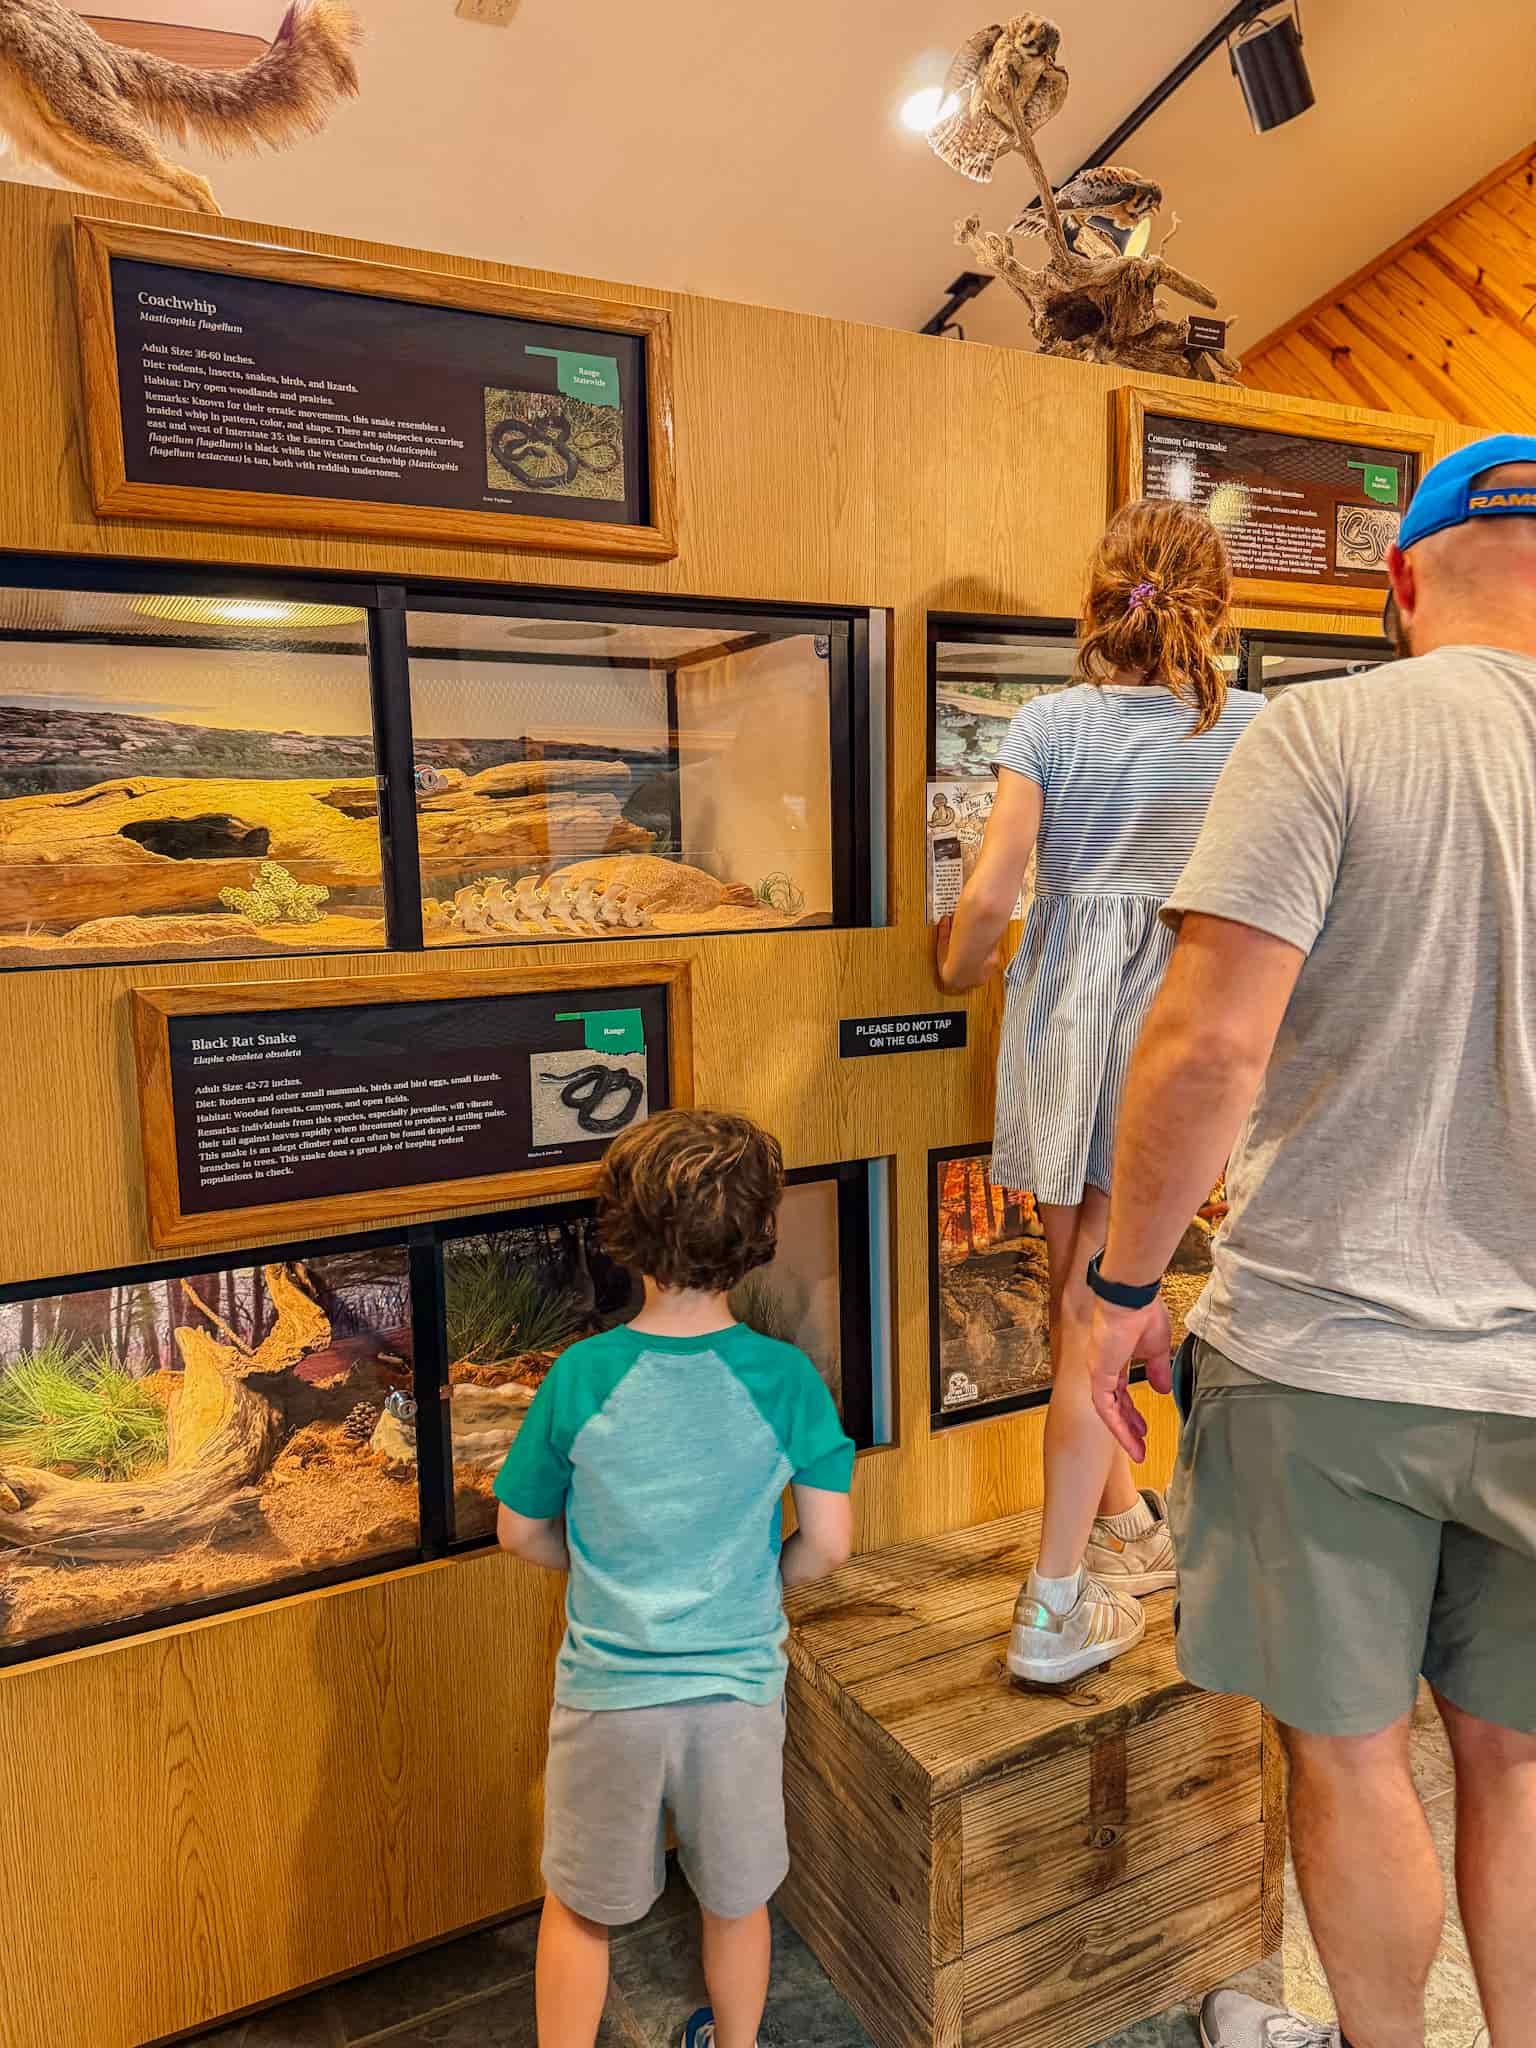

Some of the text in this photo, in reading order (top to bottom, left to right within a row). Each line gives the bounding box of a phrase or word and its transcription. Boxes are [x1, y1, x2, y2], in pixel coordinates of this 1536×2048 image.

[138, 292, 216, 315] Coachwhip
[140, 311, 242, 333] Masticophis flagellum
[142, 343, 168, 353] Adult
[195, 349, 221, 360] 36-60
[183, 379, 201, 391] Dry
[203, 383, 227, 392] open
[228, 386, 278, 398] woodlands
[279, 392, 297, 401] and
[308, 380, 325, 388] and
[191, 396, 225, 408] Known
[227, 399, 240, 409] for
[243, 402, 264, 412] their
[266, 406, 296, 416] erratic
[352, 414, 369, 424] this
[370, 417, 395, 427] snake
[397, 421, 439, 431] resembles
[146, 404, 182, 416] braided
[184, 409, 208, 421] whip
[210, 411, 220, 421] in
[287, 421, 304, 430] and
[335, 425, 360, 436] There
[362, 429, 376, 437] are
[378, 431, 423, 442] subspecies
[424, 437, 464, 448] occurring
[147, 420, 166, 428] east
[169, 422, 186, 430] and
[189, 424, 210, 433] west
[213, 425, 223, 434] of
[225, 426, 269, 439] Interstate
[286, 433, 301, 442] the
[303, 435, 335, 446] Eastern
[337, 438, 384, 452] Coachwhip
[385, 444, 437, 456] (Masticophis
[1147, 433, 1228, 452] Common Gartersnake
[148, 432, 193, 444] flagellum
[244, 441, 252, 450] is
[254, 442, 279, 453] black
[281, 446, 305, 456] while
[307, 448, 321, 457] the
[323, 450, 358, 461] Western
[359, 454, 406, 467] Coachwhip
[408, 459, 458, 471] (Masticophis
[150, 445, 194, 457] flagellum
[243, 454, 252, 463] is
[272, 457, 293, 467] both
[295, 460, 315, 470] with
[316, 463, 350, 473] reddish
[856, 1019, 951, 1035] PLEASE DO NOT TAP
[191, 1032, 296, 1050] Black Rat Snake
[869, 1032, 938, 1047] ON THE GLASS
[193, 1049, 301, 1064] Elaphe obsoleta obsoleta
[194, 1084, 220, 1094] Adult
[244, 1079, 269, 1089] 42-72
[219, 1096, 255, 1106] Rodents
[257, 1093, 274, 1102] and
[275, 1092, 299, 1100] other
[301, 1088, 324, 1098] small
[370, 1082, 392, 1091] birds
[393, 1080, 409, 1089] and
[410, 1079, 427, 1088] bird
[450, 1075, 472, 1084] small
[233, 1108, 269, 1118] Wooded
[344, 1098, 360, 1107] and
[362, 1098, 383, 1107] open
[241, 1119, 290, 1132] Individuals
[292, 1118, 313, 1126] from
[315, 1115, 332, 1124] this
[367, 1107, 408, 1119] especially
[465, 1100, 494, 1109] vibrate
[198, 1139, 220, 1148] their
[222, 1136, 236, 1146] tail
[238, 1134, 270, 1145] against
[271, 1131, 300, 1140] leaves
[301, 1127, 332, 1137] rapidly
[333, 1125, 357, 1133] when
[359, 1119, 402, 1131] threatened
[414, 1116, 446, 1126] produce
[455, 1111, 483, 1120] rattling
[198, 1151, 219, 1160] This
[221, 1148, 247, 1158] snake
[249, 1147, 257, 1155] is
[259, 1146, 270, 1154] an
[272, 1143, 296, 1152] adept
[298, 1139, 331, 1149] climber
[332, 1136, 348, 1145] and
[366, 1133, 388, 1141] often
[390, 1131, 400, 1139] be
[402, 1127, 426, 1137] found
[456, 1123, 481, 1131] across
[199, 1162, 240, 1173] branches
[242, 1159, 252, 1168] in
[279, 1154, 299, 1163] This
[300, 1151, 326, 1161] snake
[327, 1149, 347, 1157] does
[356, 1145, 377, 1155] great
[379, 1143, 393, 1153] job
[394, 1141, 403, 1149] of
[405, 1139, 436, 1148] keeping
[438, 1135, 464, 1144] rodent
[200, 1172, 253, 1186] populations
[255, 1170, 264, 1178] in
